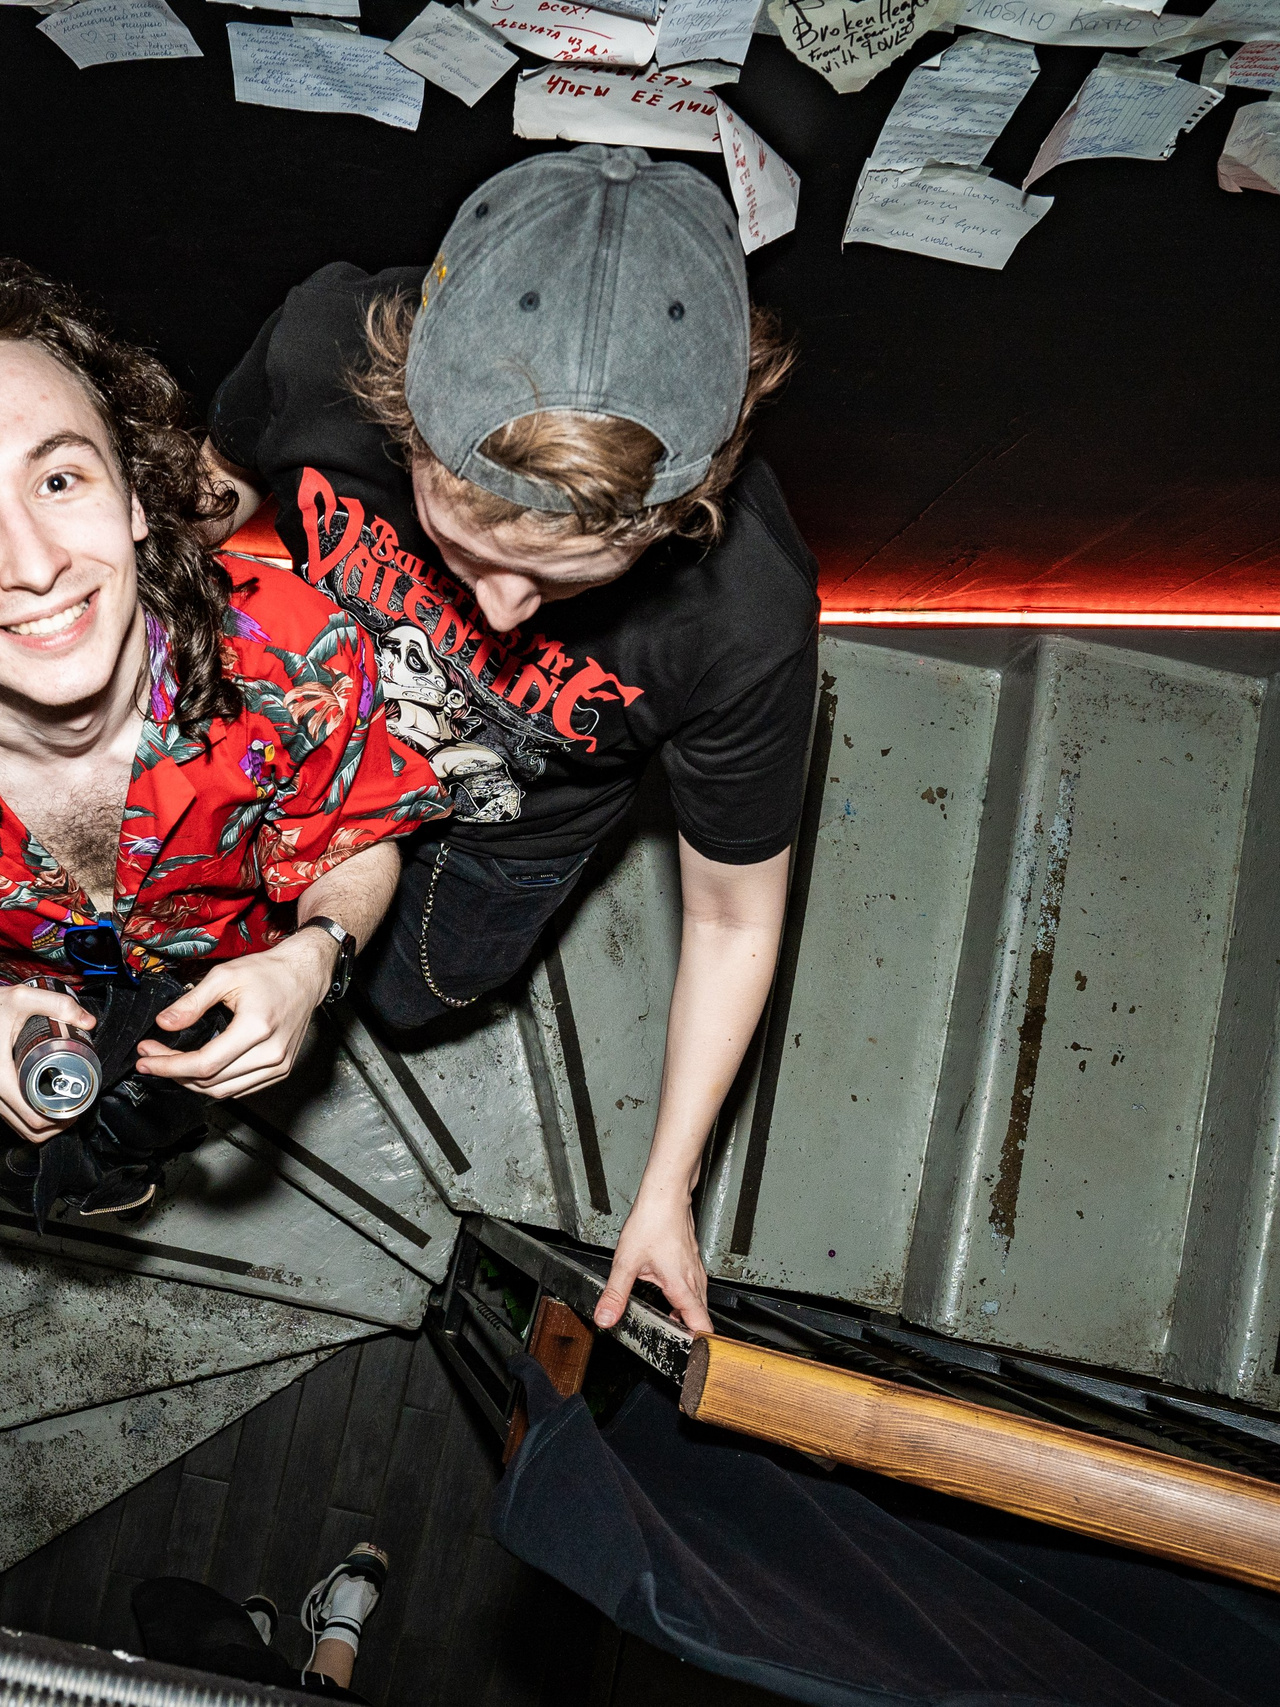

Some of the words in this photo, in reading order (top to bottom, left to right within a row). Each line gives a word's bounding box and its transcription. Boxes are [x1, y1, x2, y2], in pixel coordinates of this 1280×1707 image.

[491, 17, 561, 40] ДЕВЧАТА
[820, 52, 862, 76] with
[546, 74, 612, 98] ЧТОБЫ
[630, 88, 665, 107] ЕЁ
